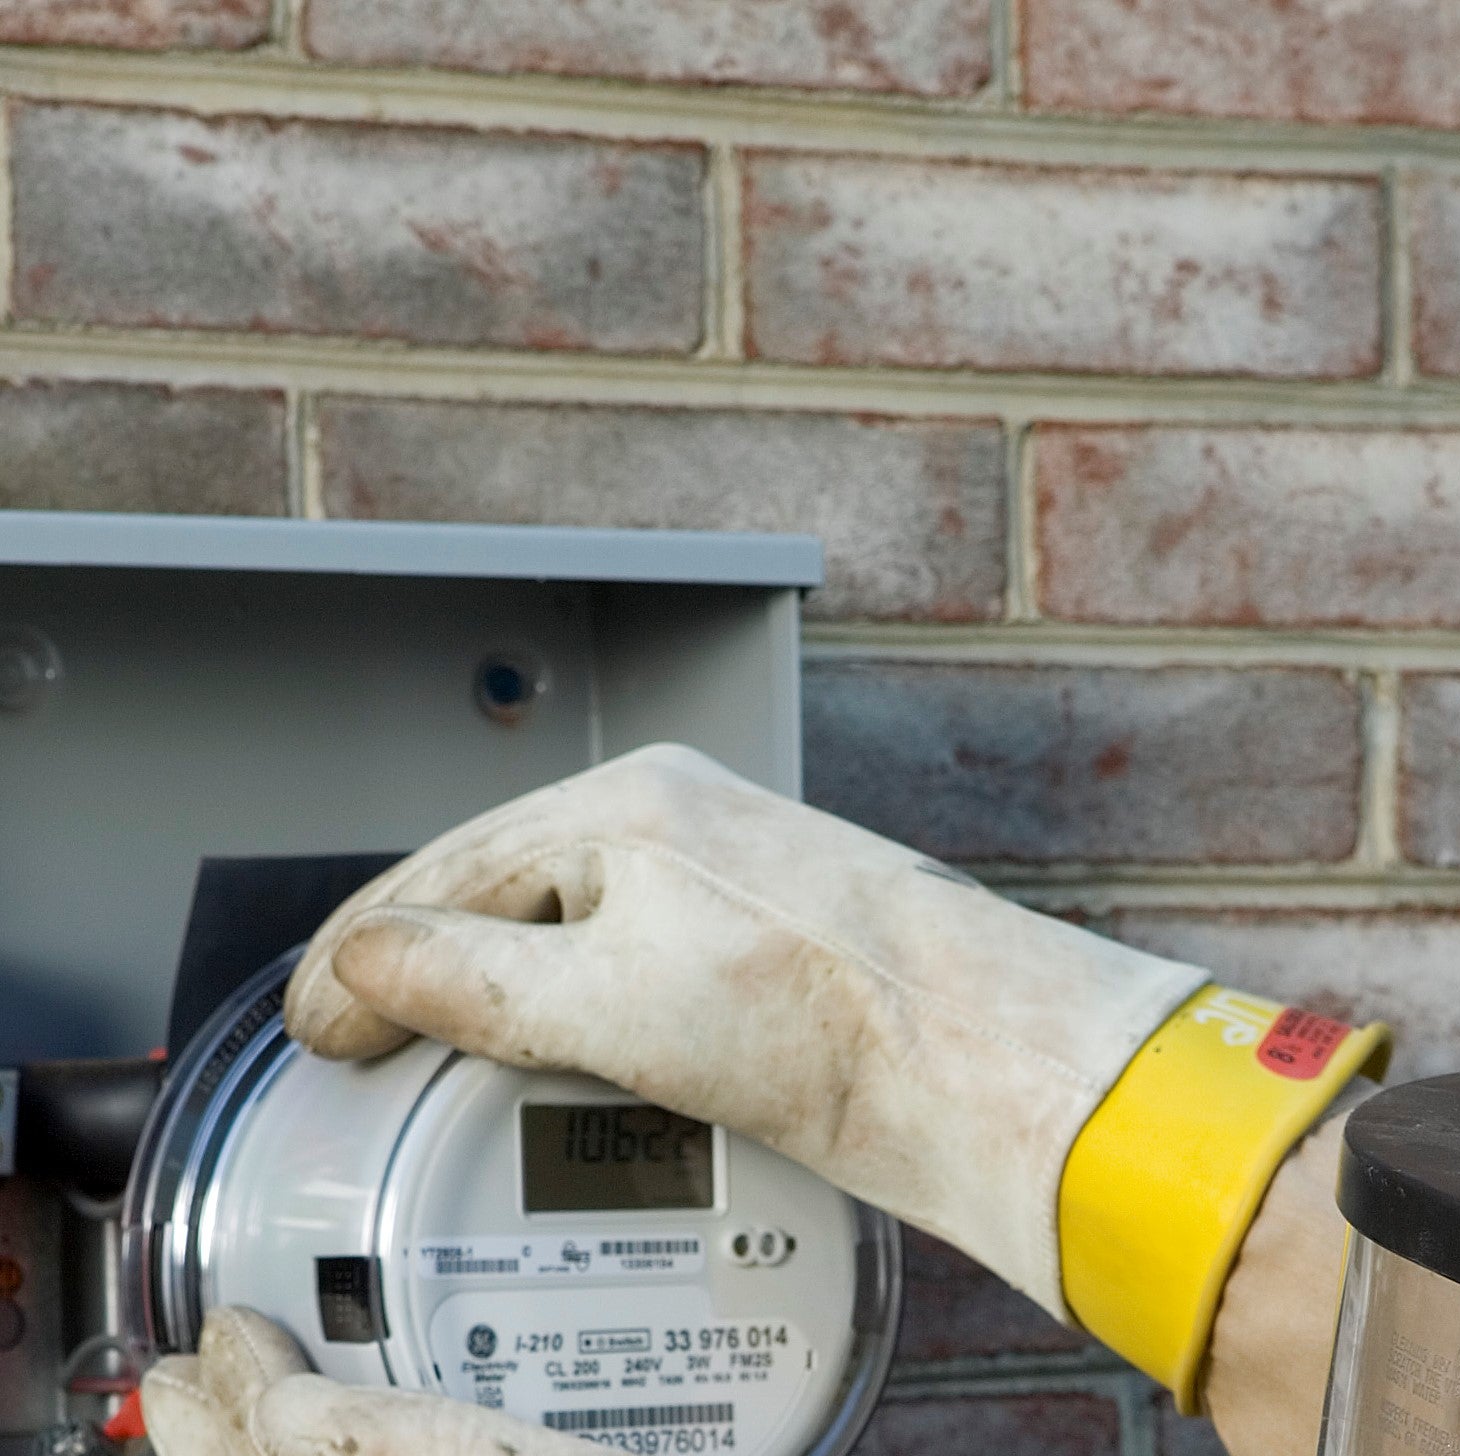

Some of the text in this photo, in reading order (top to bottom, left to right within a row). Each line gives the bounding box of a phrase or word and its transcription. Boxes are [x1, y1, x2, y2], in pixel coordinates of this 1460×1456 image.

[665, 1329, 692, 1351] 33
[700, 1327, 740, 1350] 976
[748, 1324, 788, 1348] 014
[545, 1360, 566, 1377] CL
